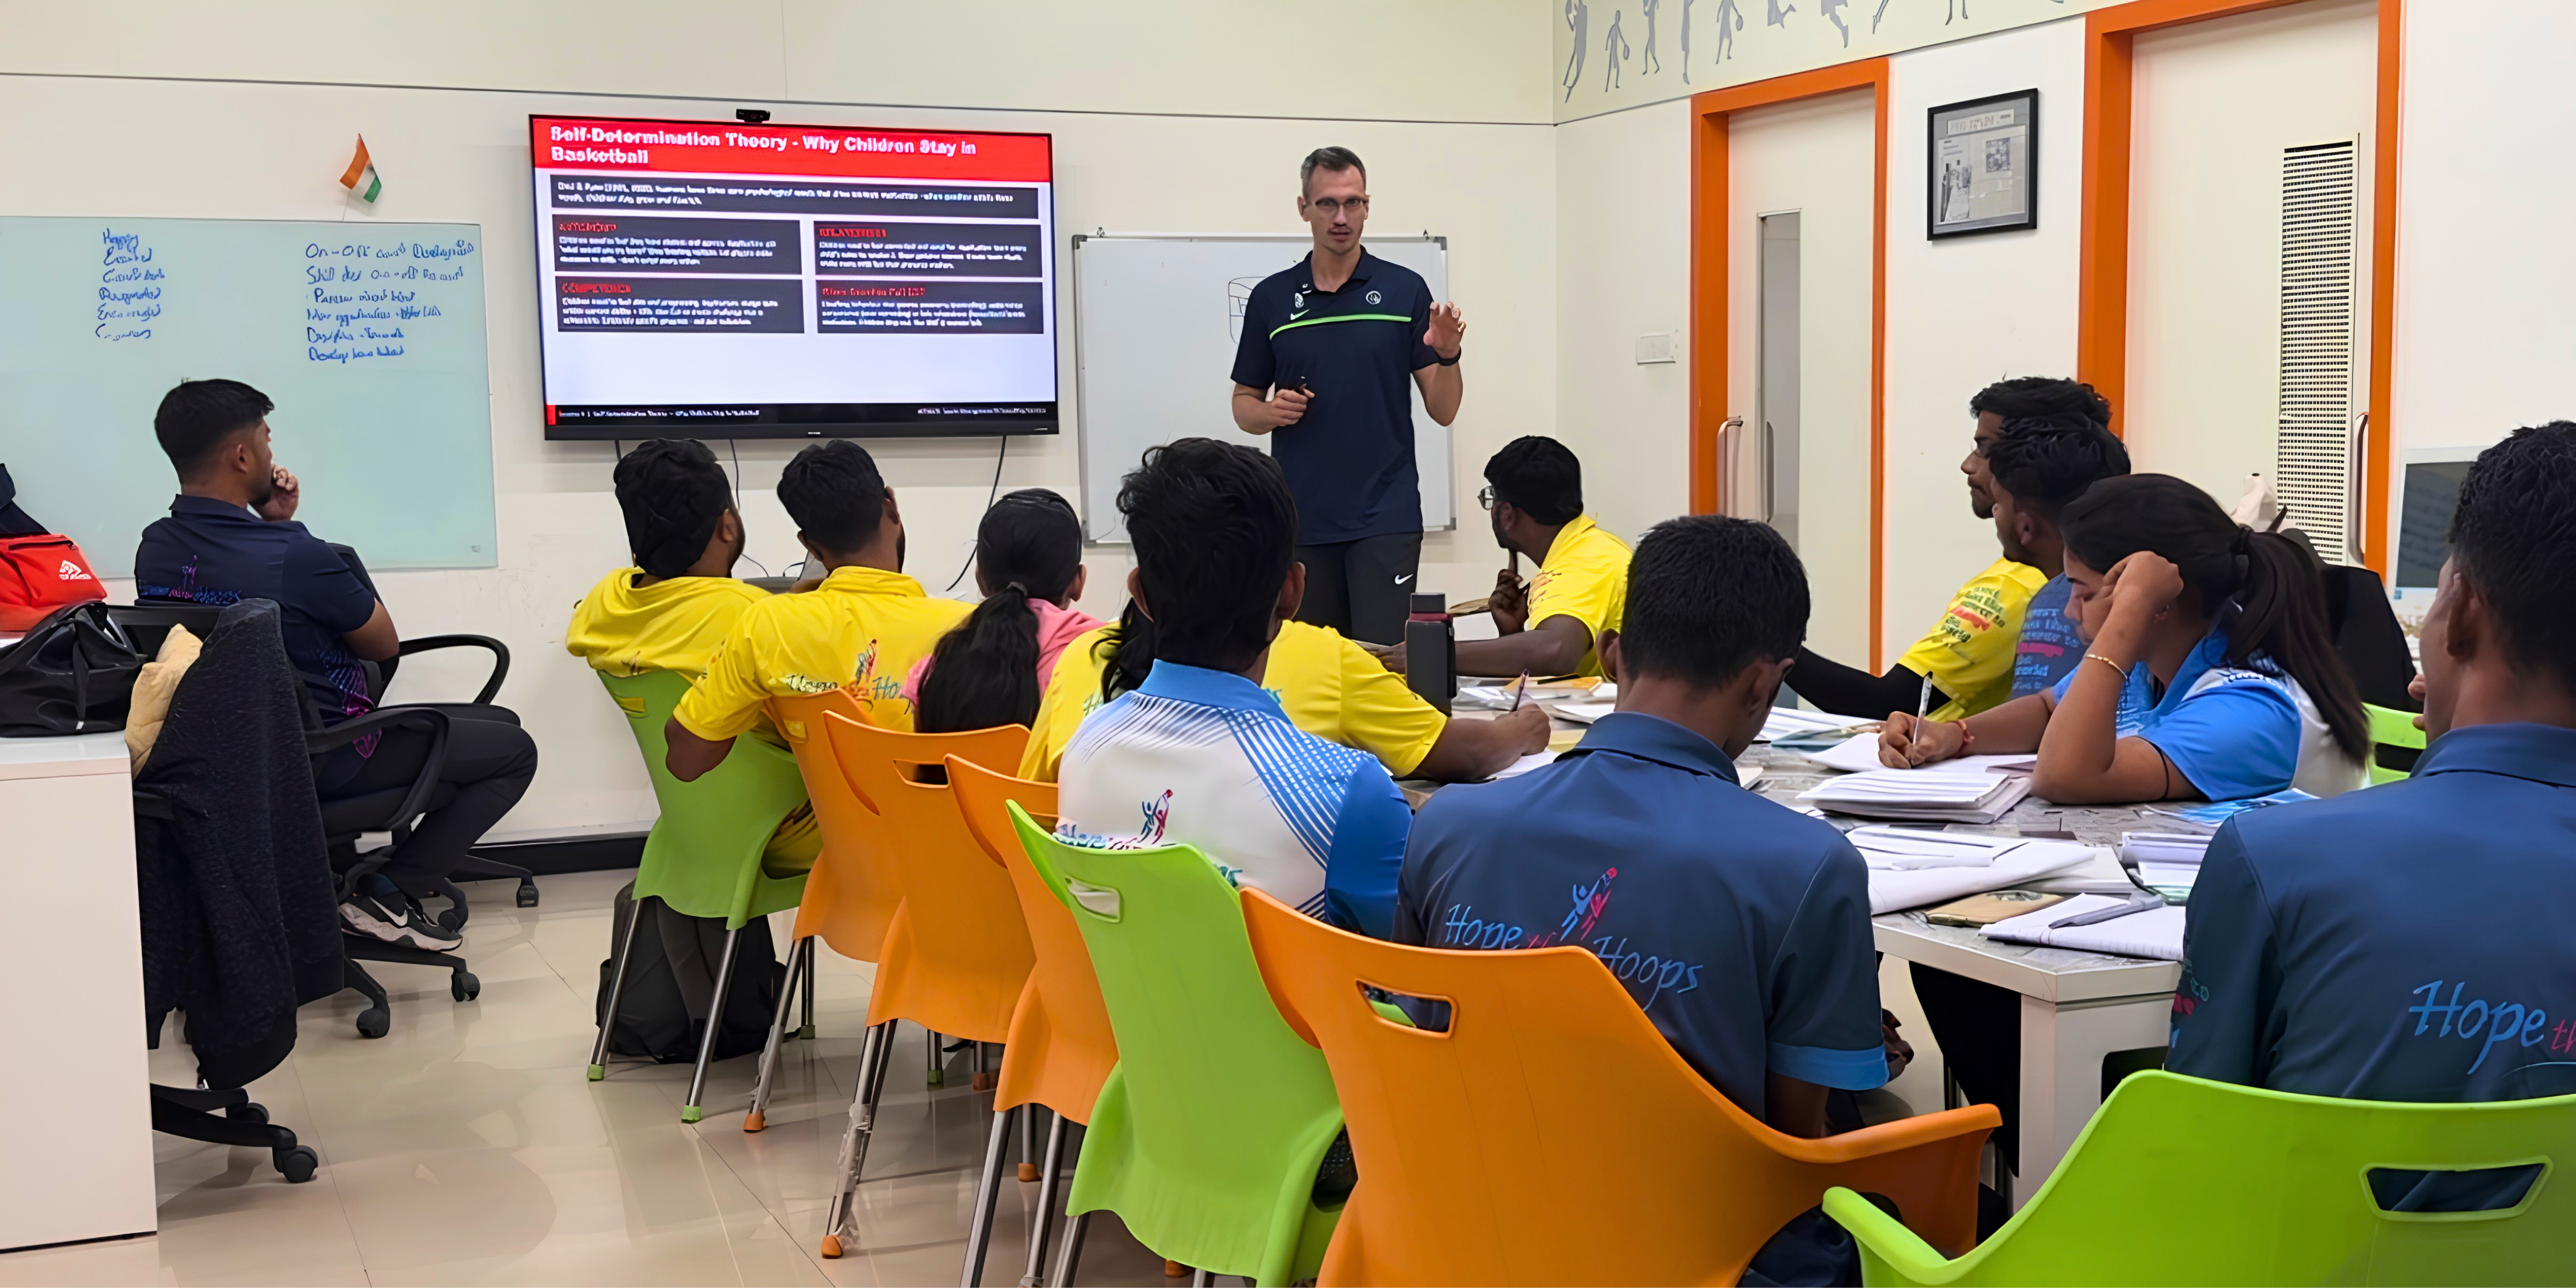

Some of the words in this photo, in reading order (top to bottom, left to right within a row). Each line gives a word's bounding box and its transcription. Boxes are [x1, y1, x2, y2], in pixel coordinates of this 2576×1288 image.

[550, 146, 648, 163] Basketball
[725, 132, 787, 152] Theory
[802, 135, 839, 154] Why
[844, 136, 915, 153] Children
[920, 139, 957, 157] Stay
[961, 141, 976, 155] in
[1445, 904, 1523, 949] Hope
[1593, 936, 1703, 1011] Hoops
[2409, 980, 2546, 1075] Hope
